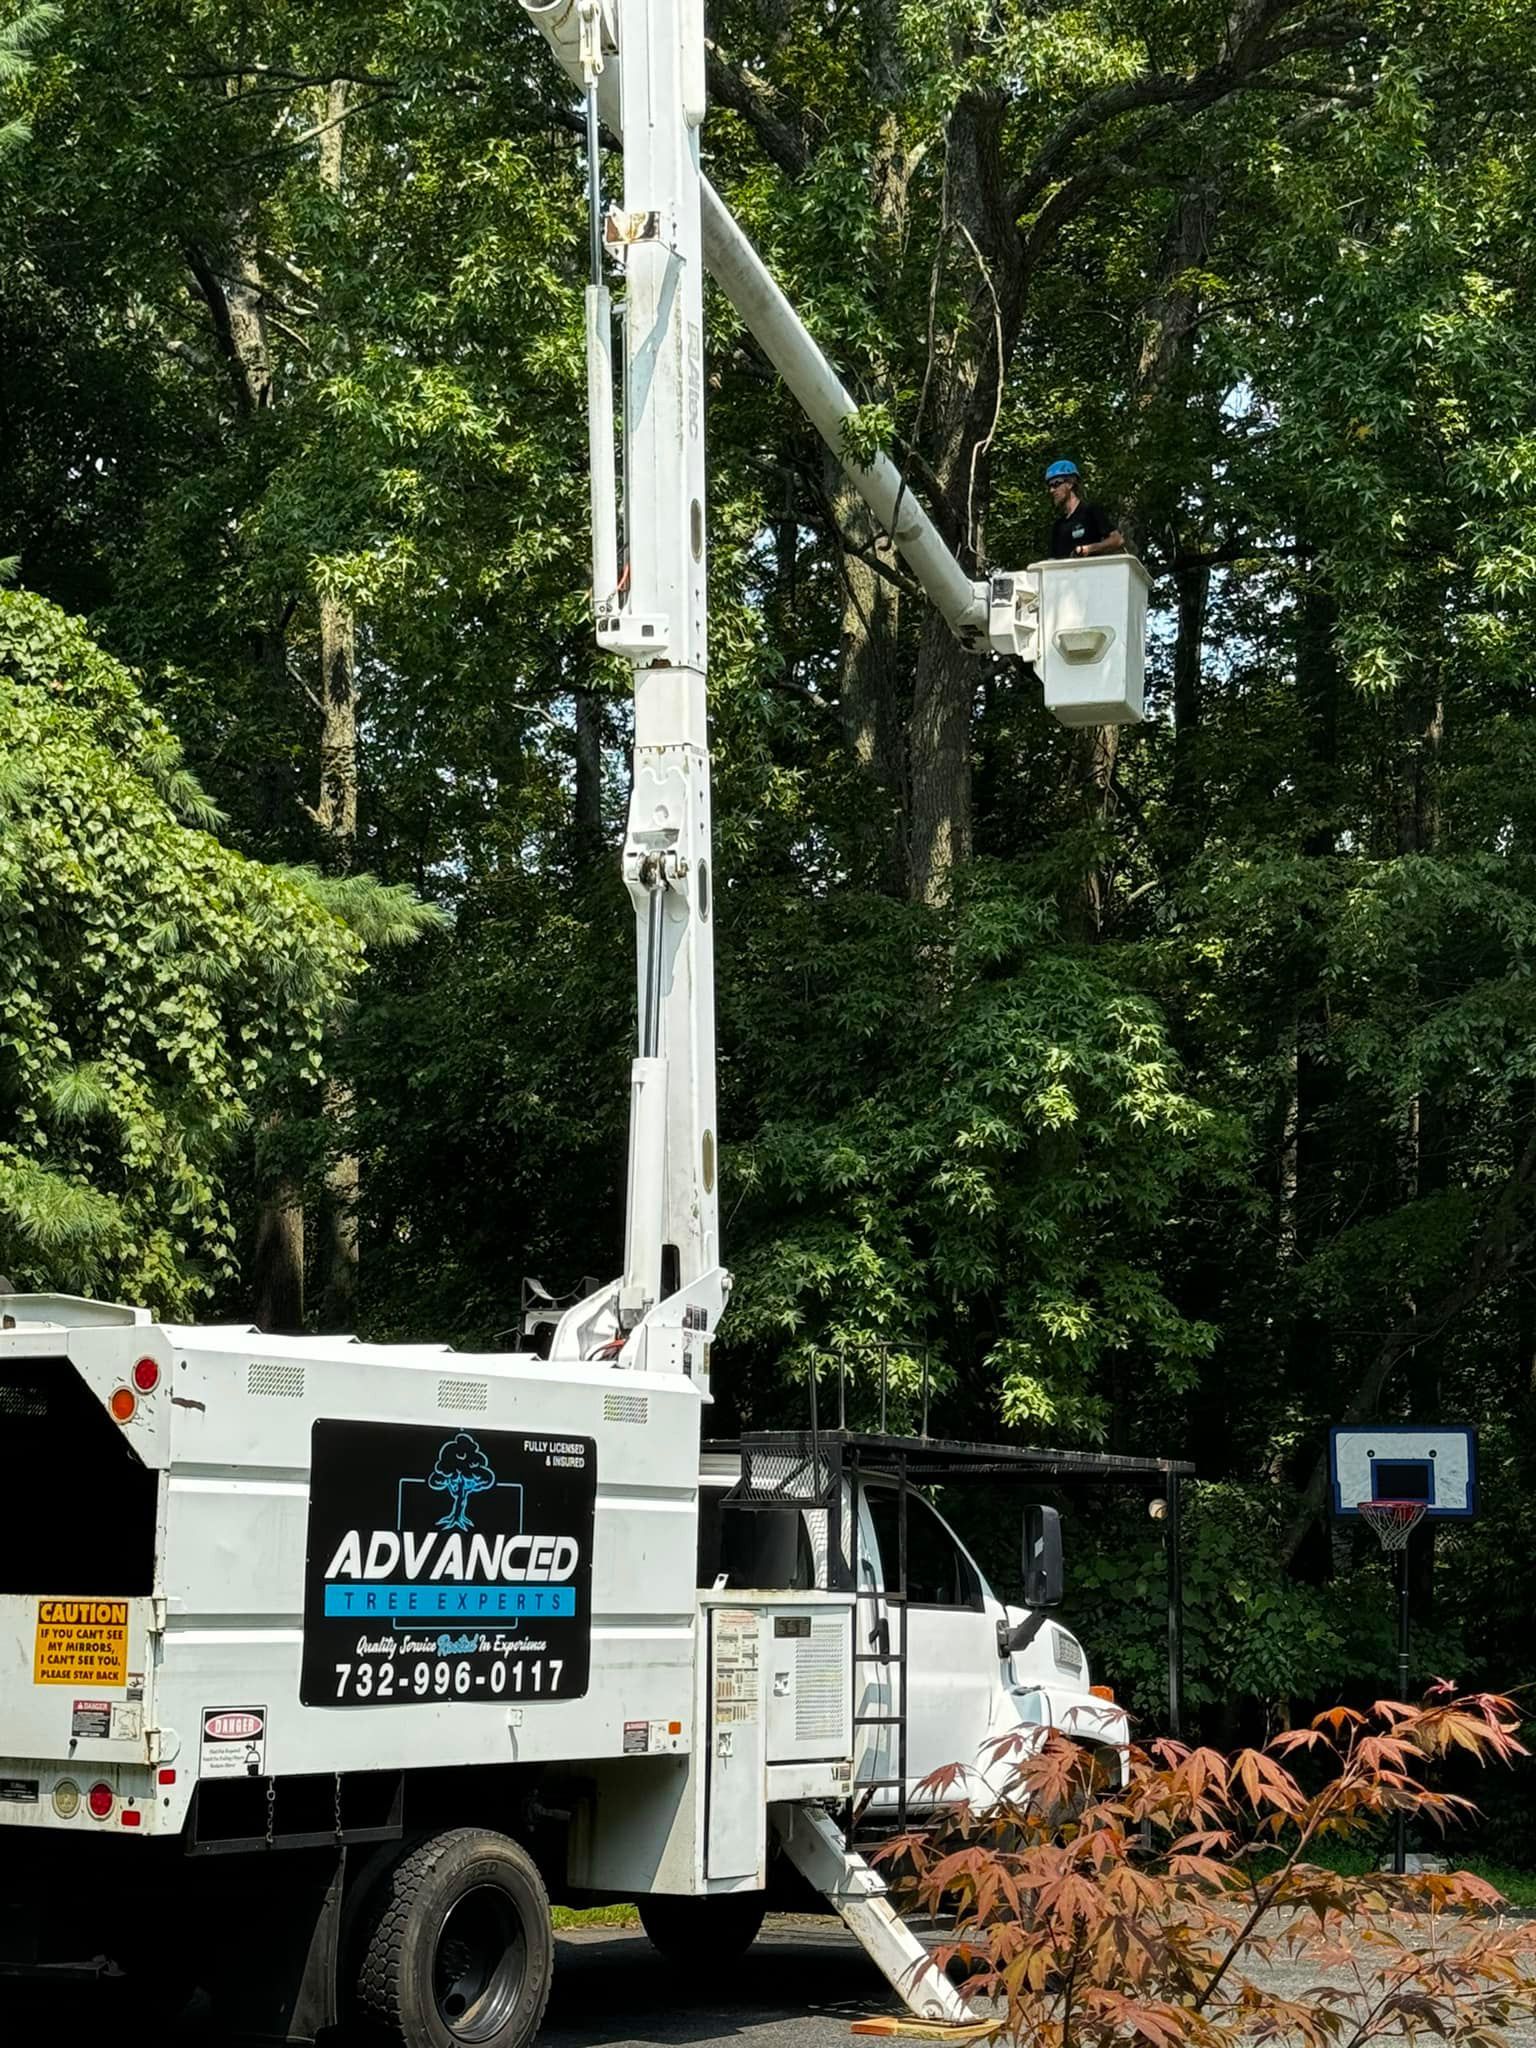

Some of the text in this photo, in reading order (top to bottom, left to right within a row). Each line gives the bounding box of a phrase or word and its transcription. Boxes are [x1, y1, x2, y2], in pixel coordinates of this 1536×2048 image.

[523, 1440, 585, 1455] FULLY LICENSED
[545, 1455, 585, 1468] & INSURED
[324, 1530, 579, 1582] ADVANCED
[344, 1592, 561, 1611] TREE EXPERTS
[40, 1603, 127, 1624] CAUTION
[41, 1629, 124, 1640] IF YOU CAN'T SEE
[47, 1641, 115, 1655] MY MIRRORS,
[356, 1635, 398, 1660] Quality
[400, 1635, 437, 1655] Service
[478, 1634, 492, 1653] In
[493, 1634, 548, 1659] Experience
[40, 1654, 121, 1667] I CAN'T SEE YOU.
[40, 1669, 119, 1681] PLEASE STAY BACK
[336, 1660, 564, 1697] 732-996-0117
[215, 1718, 255, 1734] DANGER
